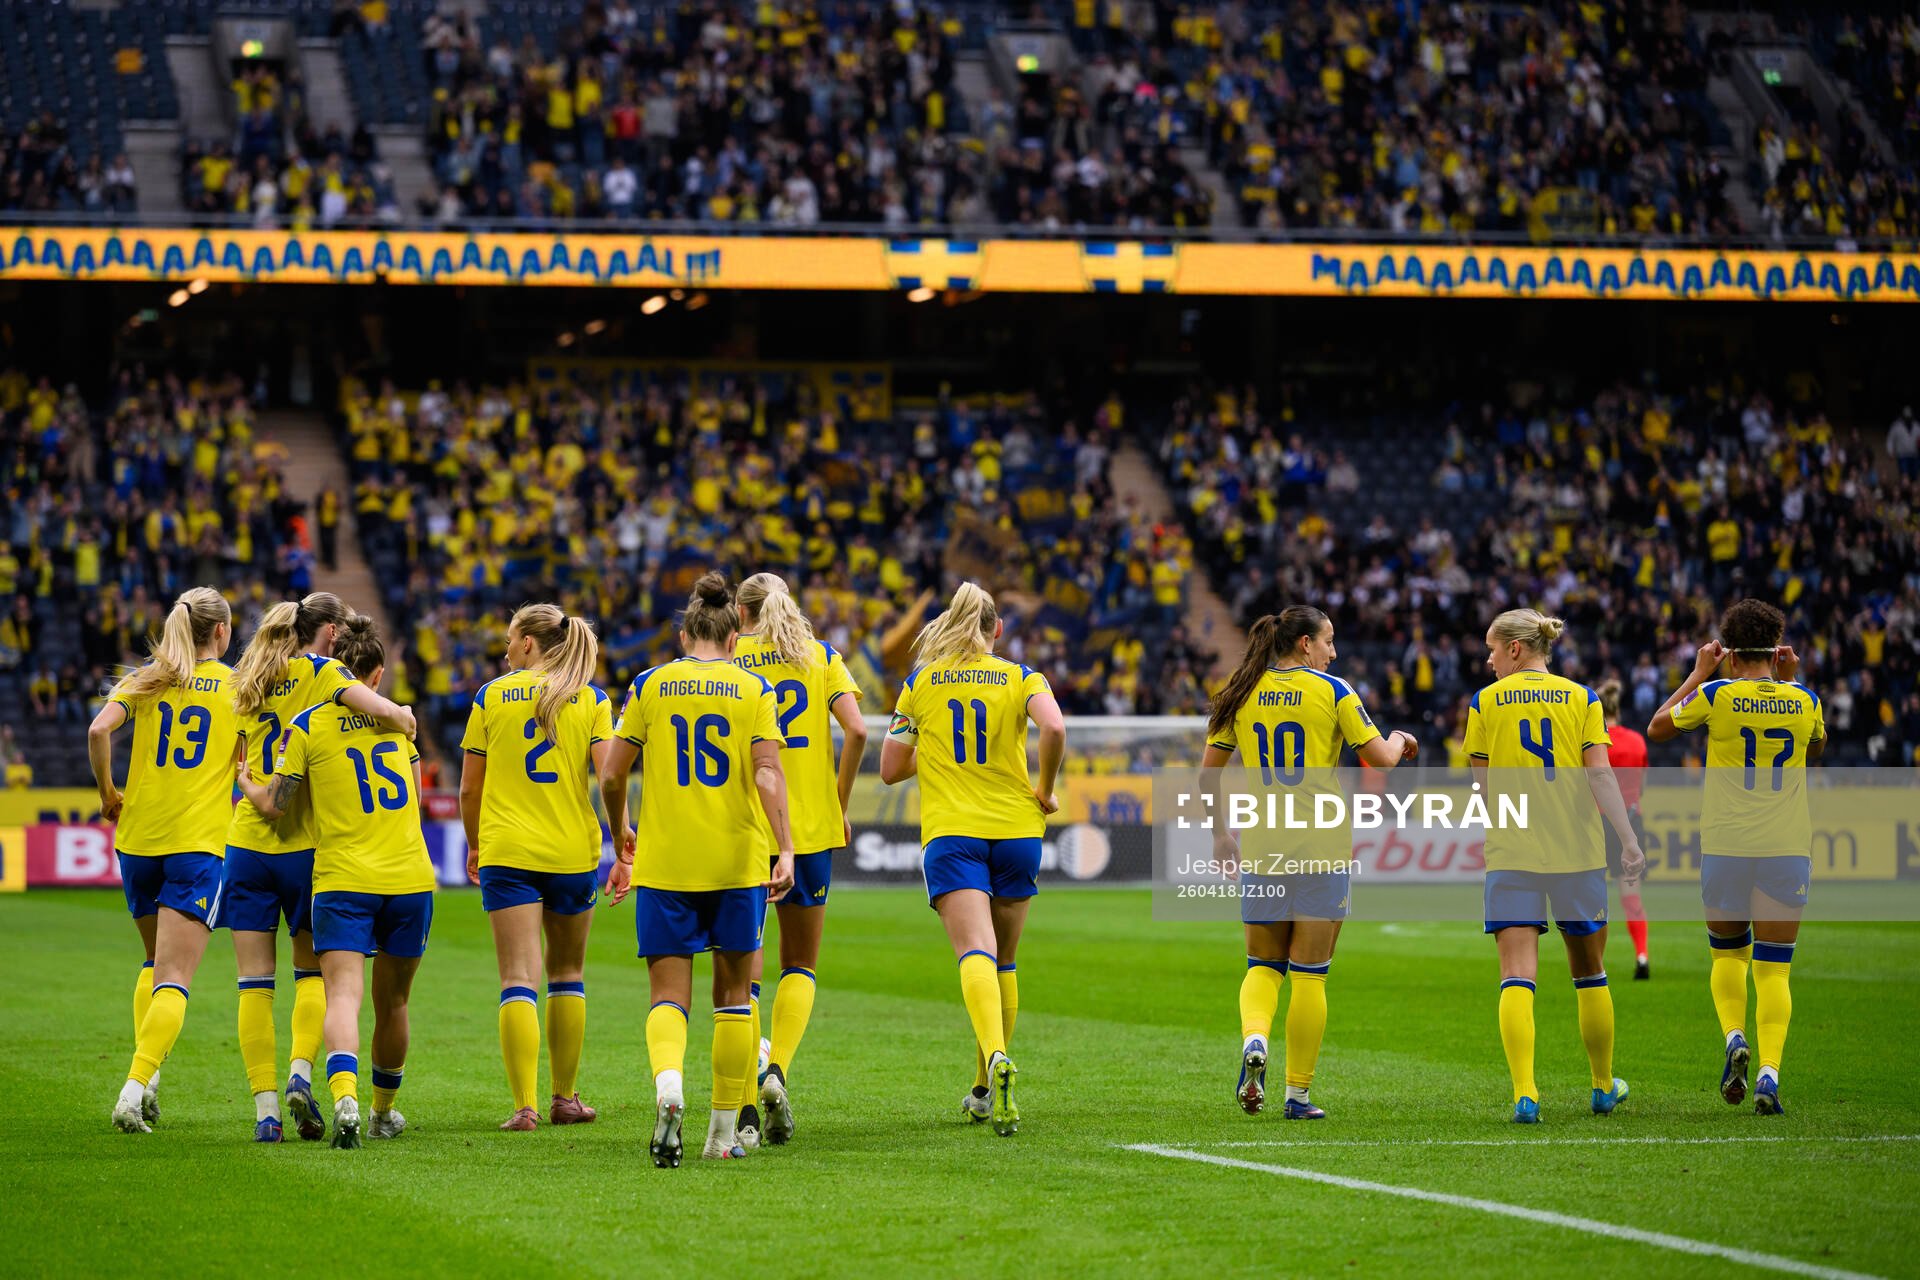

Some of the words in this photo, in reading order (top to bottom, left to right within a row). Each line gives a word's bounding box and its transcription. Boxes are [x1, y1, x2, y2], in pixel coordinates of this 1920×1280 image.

[659, 680, 743, 700] ANGELDAHL
[931, 669, 1008, 686] BLACKSTENIUS
[1258, 690, 1303, 706] KAFAJI
[1495, 689, 1572, 706] LUNDKVIST
[1732, 696, 1803, 715] SCHRÖDER
[156, 700, 212, 770] 13
[258, 711, 282, 775] 7
[523, 717, 559, 784] 2
[670, 713, 731, 788] 16
[947, 698, 987, 765] 11
[1252, 721, 1306, 787] 10
[1518, 717, 1557, 782] 4
[1739, 726, 1795, 792] 17
[345, 741, 409, 814] 15
